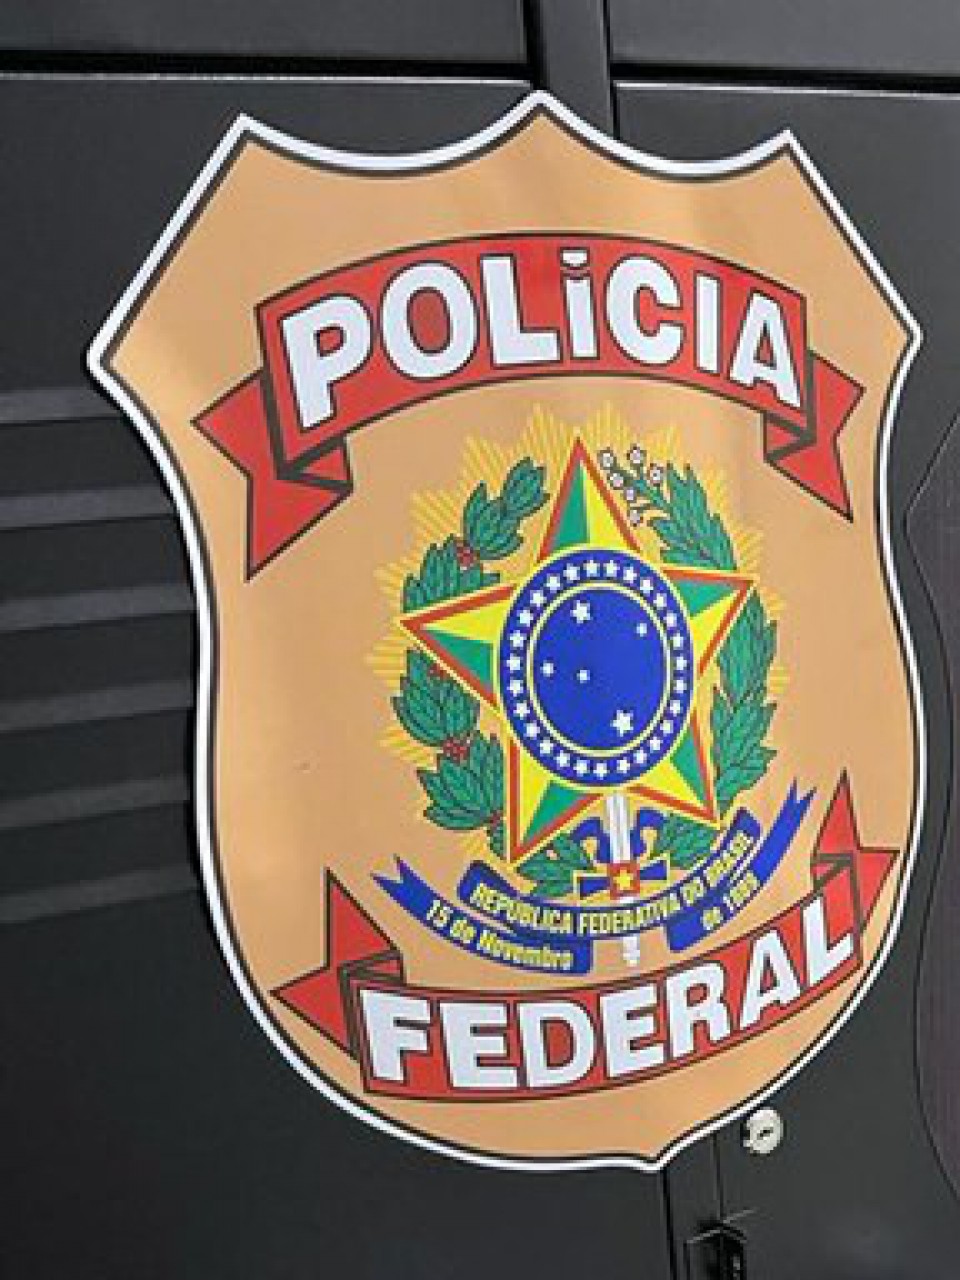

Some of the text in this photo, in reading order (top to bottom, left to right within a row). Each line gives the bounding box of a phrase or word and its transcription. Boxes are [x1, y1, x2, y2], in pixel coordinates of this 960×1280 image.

[357, 896, 856, 1091] FEDERAL
[426, 898, 574, 970] 15 de Novembro
